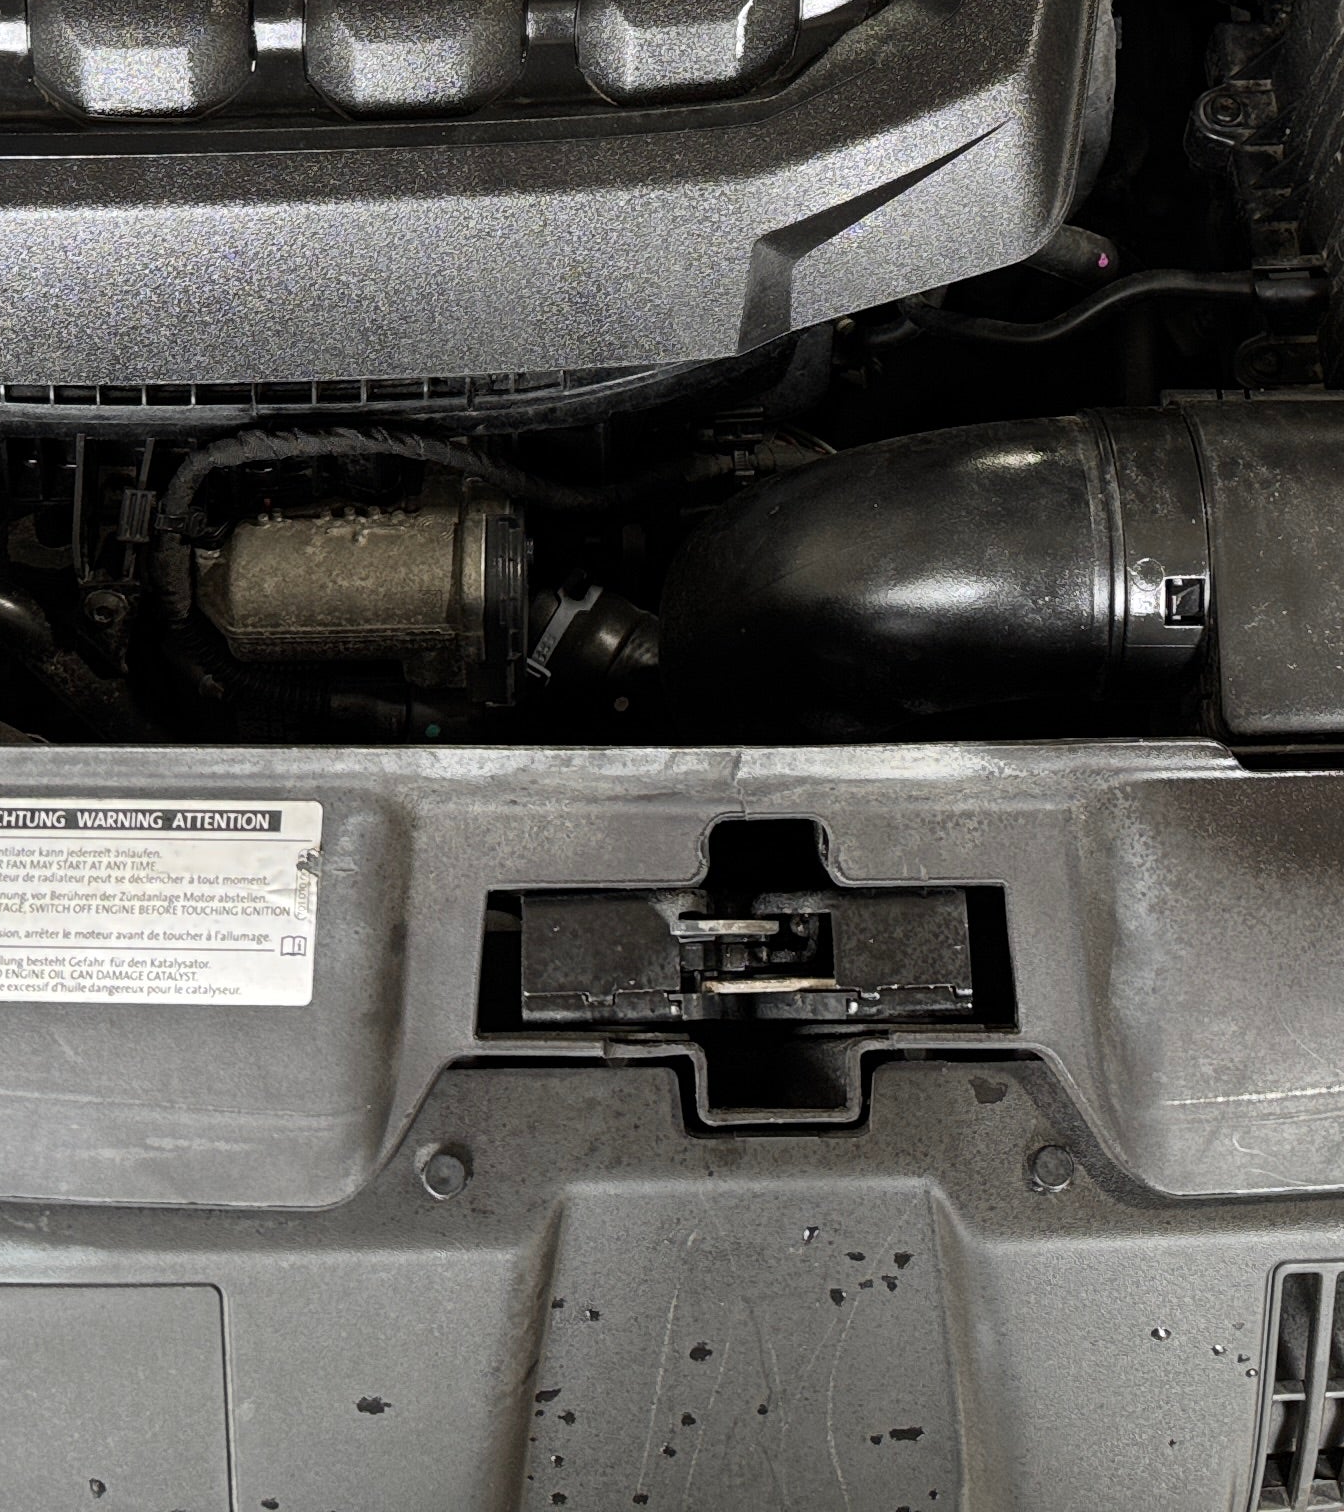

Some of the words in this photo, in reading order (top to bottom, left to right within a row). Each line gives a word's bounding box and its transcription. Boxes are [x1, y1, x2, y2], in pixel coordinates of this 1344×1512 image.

[76, 811, 163, 829] WARNING
[172, 812, 270, 830] ATTENTION
[39, 848, 64, 858] kann
[66, 848, 111, 860] jederzeit
[6, 859, 27, 870] FAN
[30, 860, 54, 870] MAY
[57, 860, 88, 870] START
[89, 861, 103, 870] AT
[105, 861, 128, 871] ANY
[22, 872, 35, 883] de
[38, 873, 85, 883] radiateur
[88, 874, 111, 885] peut
[115, 876, 126, 884] se
[128, 872, 184, 885] déclencher
[188, 873, 195, 885] à
[197, 875, 219, 885] tout
[222, 876, 270, 886] moment.
[31, 892, 47, 901] vor
[50, 890, 97, 902] Berühren
[100, 892, 117, 902] der
[119, 892, 181, 905] Zündanlage
[183, 893, 216, 903] Motor
[218, 893, 269, 904] abstellen.
[29, 903, 70, 914] SWITCH
[73, 904, 93, 914] OFF
[96, 904, 136, 915] ENGINE
[138, 904, 178, 916] BEFORE
[181, 905, 238, 916] TOUCHING
[241, 905, 290, 917] IGNITION
[24, 928, 59, 939] arrêter
[62, 928, 71, 939] le
[75, 930, 114, 940] moteur
[116, 931, 145, 940] avant
[148, 930, 160, 940] de
[162, 930, 204, 941] toucher
[206, 930, 212, 942] à
[27, 956, 66, 966] besteht
[68, 956, 104, 968] Gefahr
[110, 958, 125, 968] für
[128, 958, 147, 968] den
[150, 958, 211, 972] Katalysator.
[5, 968, 45, 979] ENGINE
[48, 969, 66, 980] OIL
[70, 970, 94, 980] CAN
[96, 970, 144, 981] DAMAGE
[7, 982, 50, 992] excessif
[51, 982, 86, 993] d'huile
[88, 983, 145, 996] dangereux
[147, 985, 172, 996] pour
[175, 984, 182, 994] le
[186, 985, 241, 998] catalyseur.
